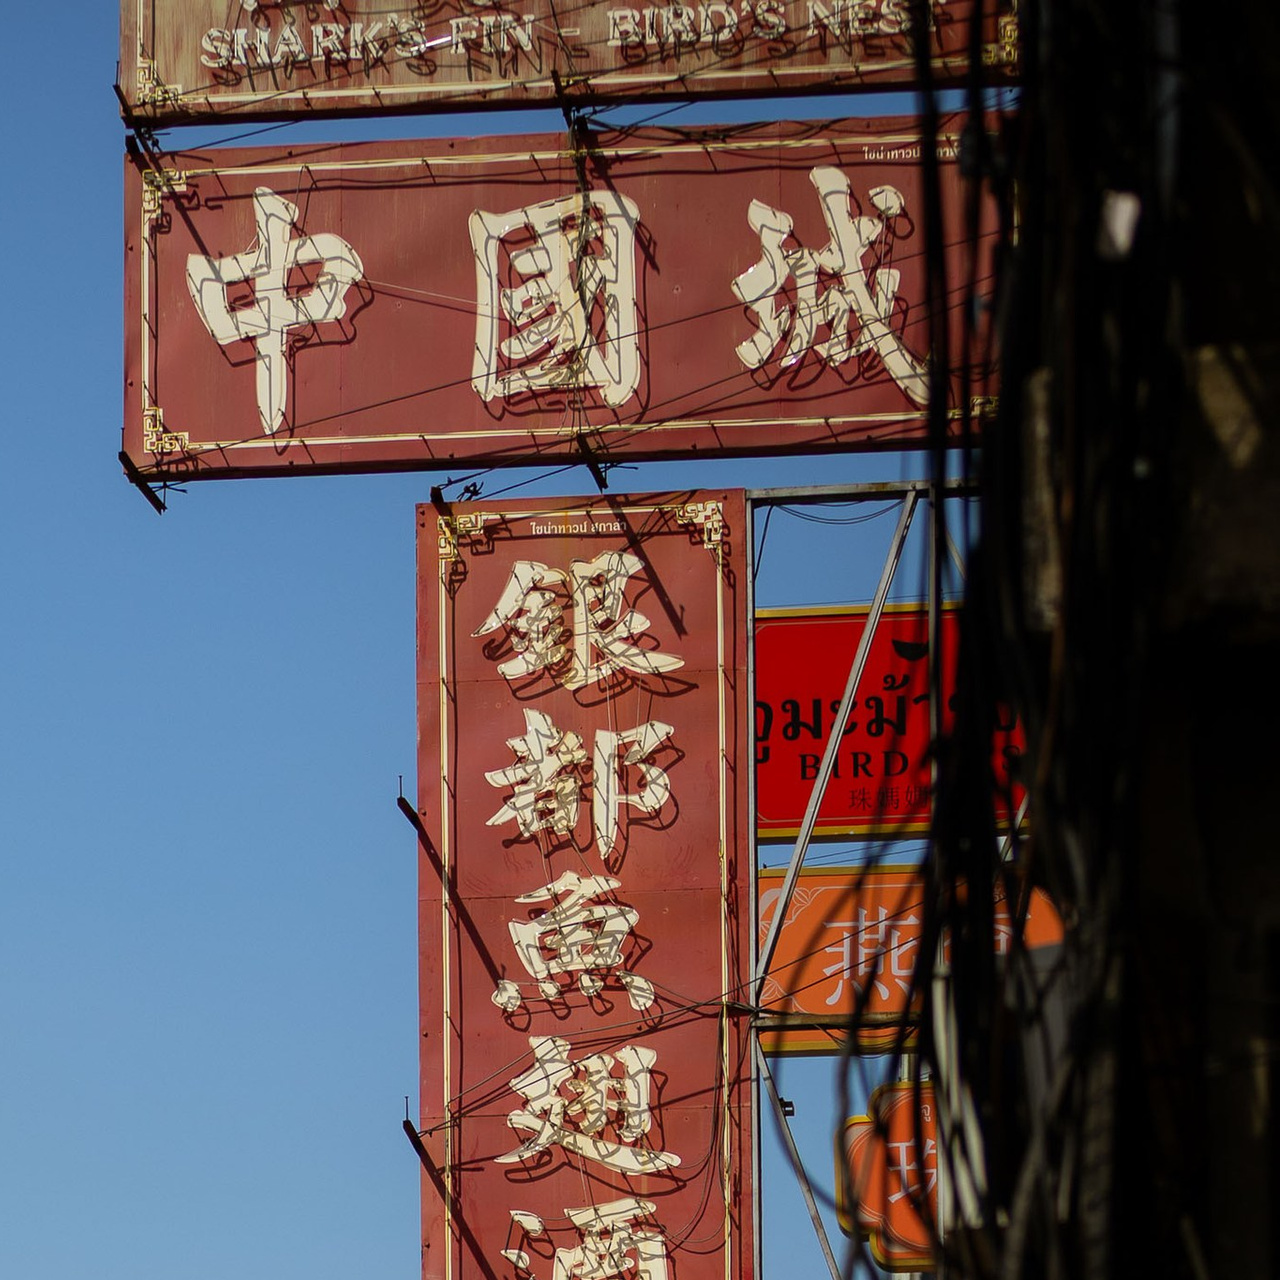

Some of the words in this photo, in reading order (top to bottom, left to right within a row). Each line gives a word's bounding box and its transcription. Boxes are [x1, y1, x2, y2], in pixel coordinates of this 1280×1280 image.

[200, 14, 427, 68] SHARK'S
[449, 12, 534, 56] FIN
[606, 0, 788, 48] BIRD'S
[186, 166, 932, 434] 中國城
